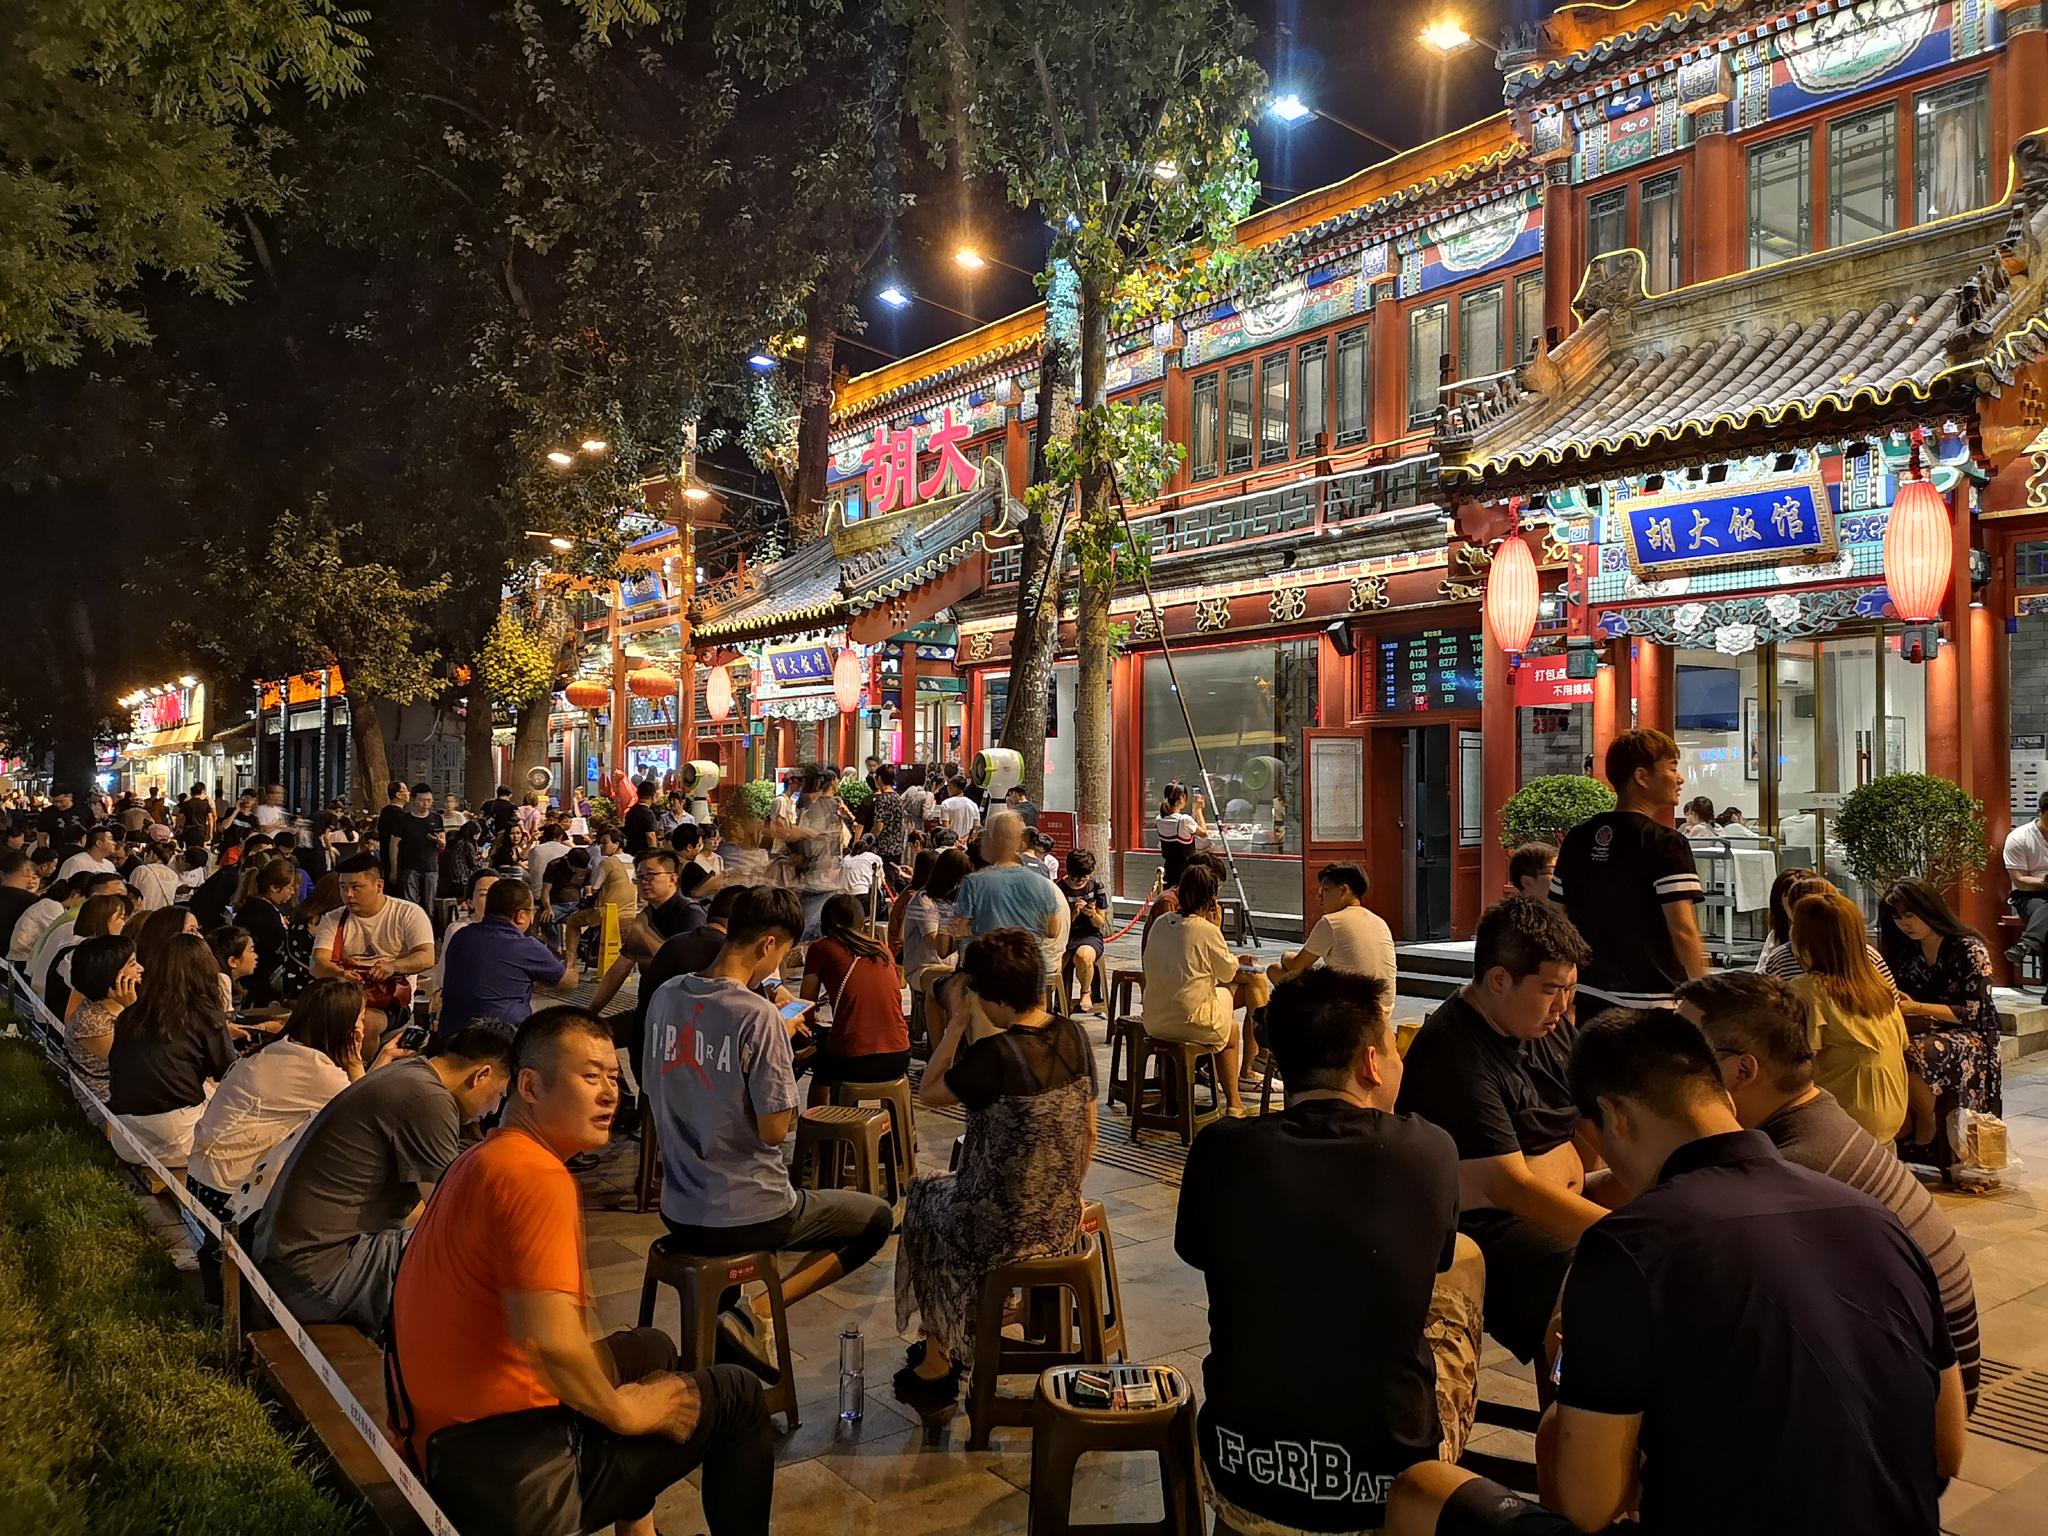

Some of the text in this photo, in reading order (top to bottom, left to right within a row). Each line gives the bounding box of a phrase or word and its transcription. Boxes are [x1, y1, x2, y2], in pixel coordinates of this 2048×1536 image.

[861, 407, 980, 512] 胡大
[1645, 496, 1804, 552] 胡大饭馆
[1438, 645, 1457, 655] A232
[1409, 660, 1428, 670] B134
[1438, 657, 1458, 667] B277
[1411, 672, 1426, 681] C30
[1441, 670, 1456, 679] C65
[1441, 682, 1457, 691] D52
[1553, 683, 1594, 696] 不用排队
